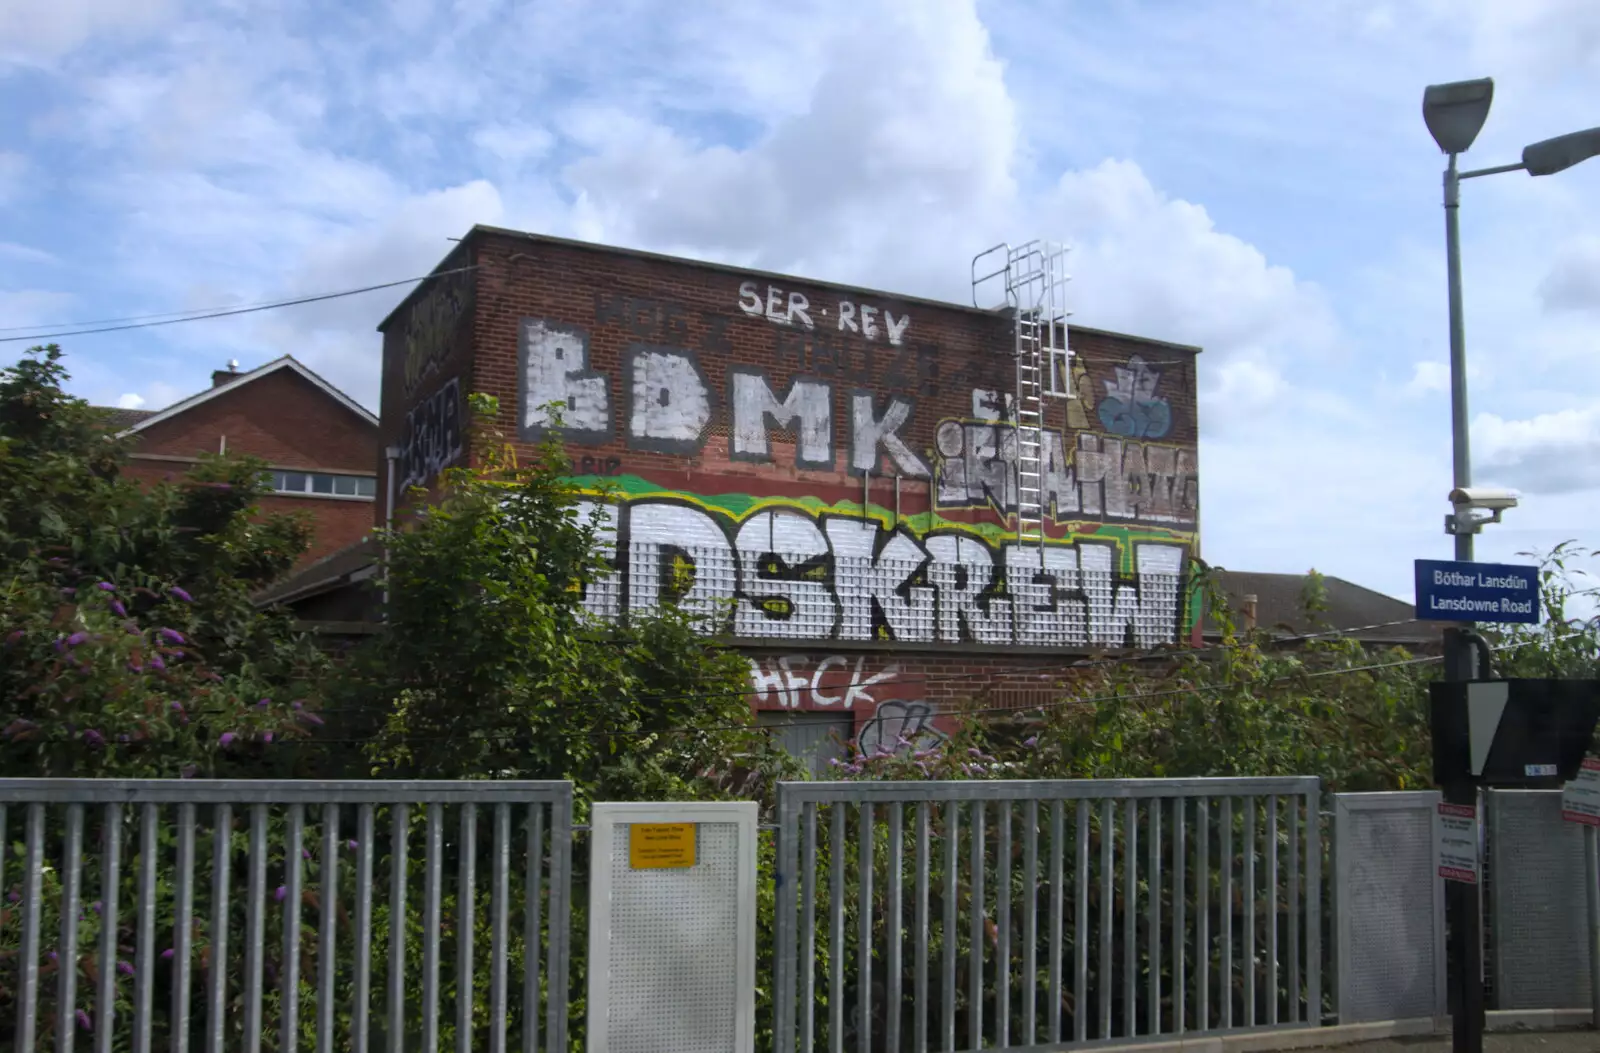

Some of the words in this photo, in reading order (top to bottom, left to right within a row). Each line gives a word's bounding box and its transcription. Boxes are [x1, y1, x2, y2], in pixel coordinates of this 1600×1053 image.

[738, 281, 815, 331] SER
[838, 301, 911, 346] REV
[1433, 570, 1476, 588] Bóthar
[1430, 594, 1499, 612] Lansdowne
[1500, 597, 1532, 614] Road
